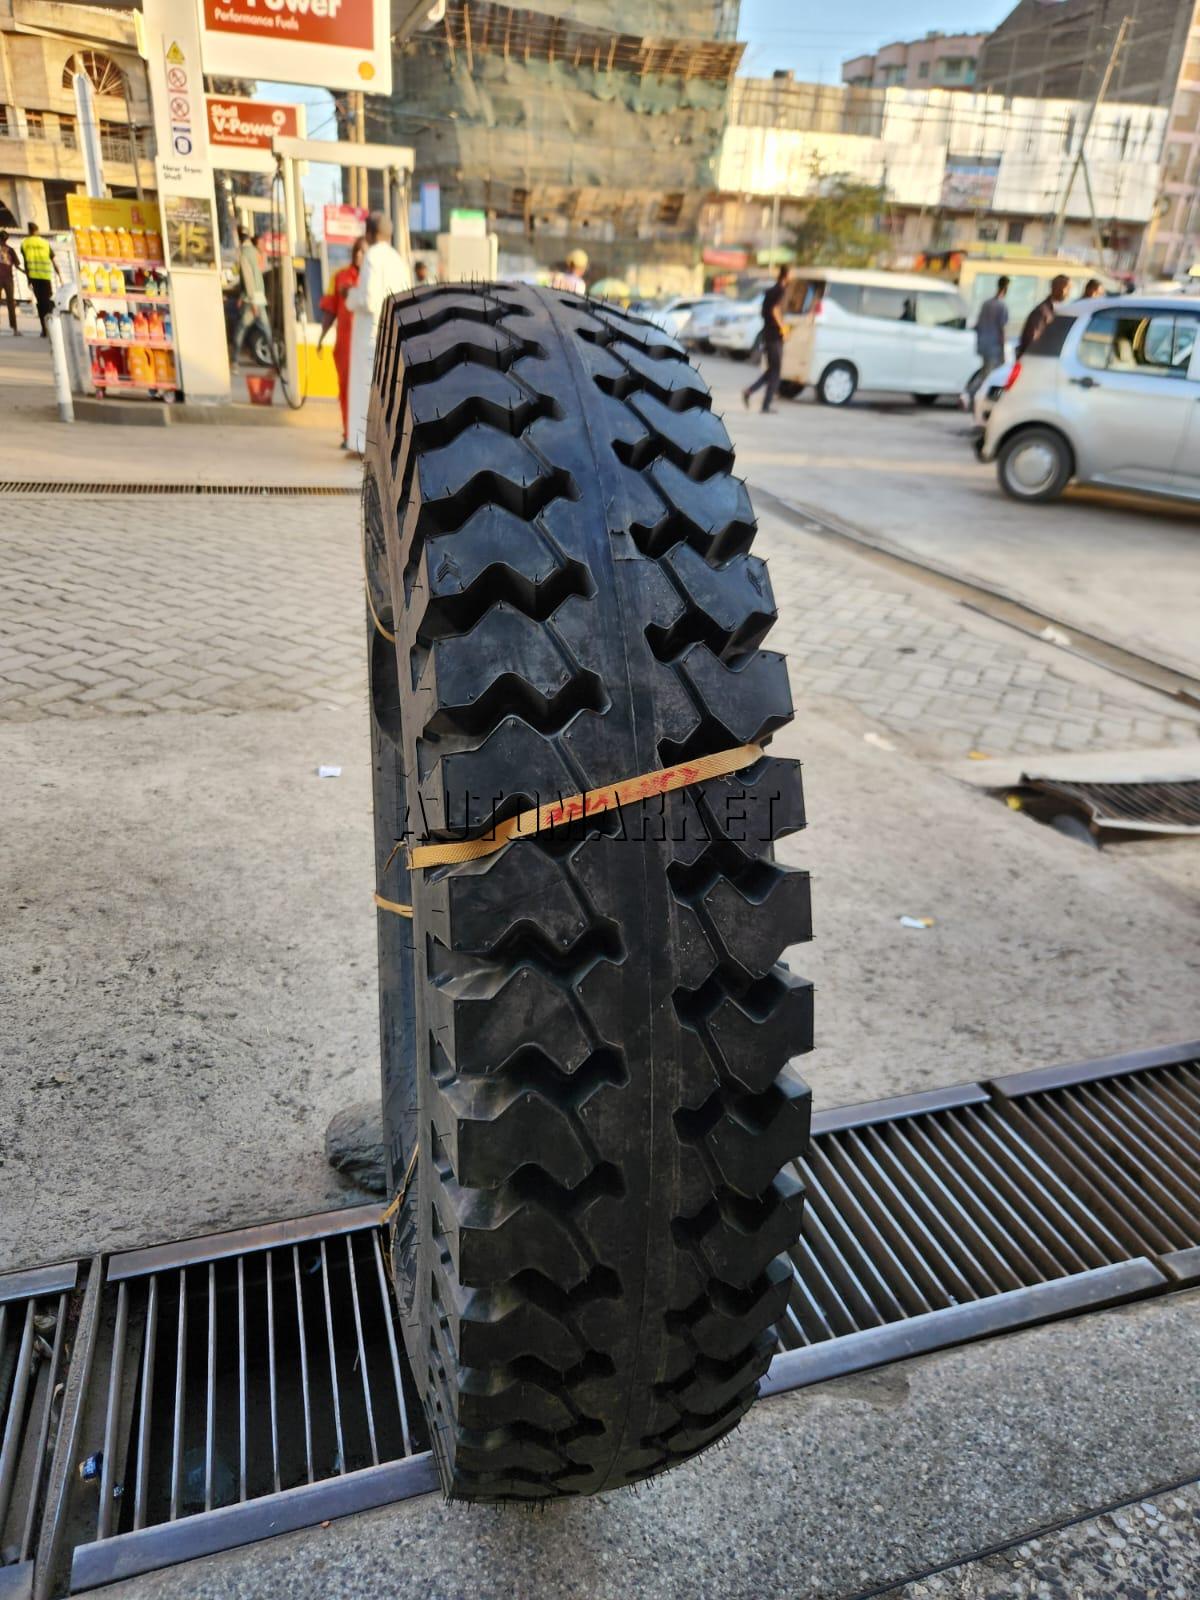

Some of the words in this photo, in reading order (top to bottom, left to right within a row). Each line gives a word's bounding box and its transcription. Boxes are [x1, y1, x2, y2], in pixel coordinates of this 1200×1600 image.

[214, 7, 274, 28] Performance
[275, 14, 299, 31] Fuels
[211, 104, 238, 118] Shell
[212, 117, 281, 137] V-Power
